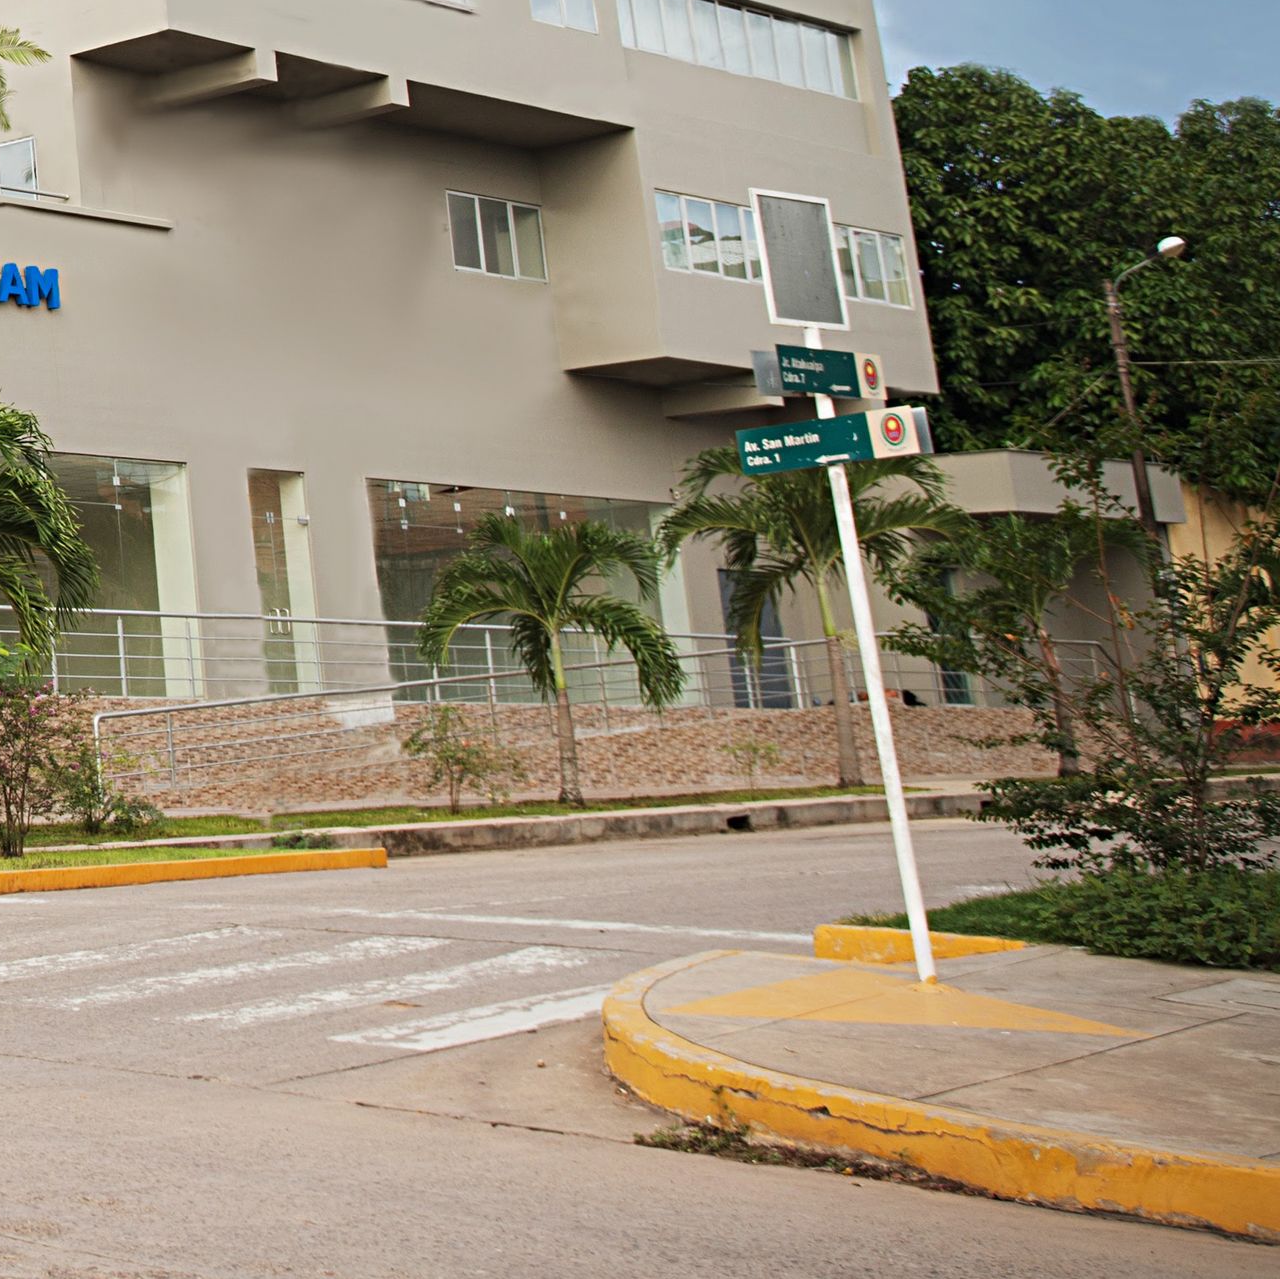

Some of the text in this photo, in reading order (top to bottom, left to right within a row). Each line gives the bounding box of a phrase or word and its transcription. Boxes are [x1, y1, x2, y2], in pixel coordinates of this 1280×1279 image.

[744, 441, 761, 452] Av.
[761, 438, 783, 451] San
[746, 453, 781, 467] Cdra. 1
